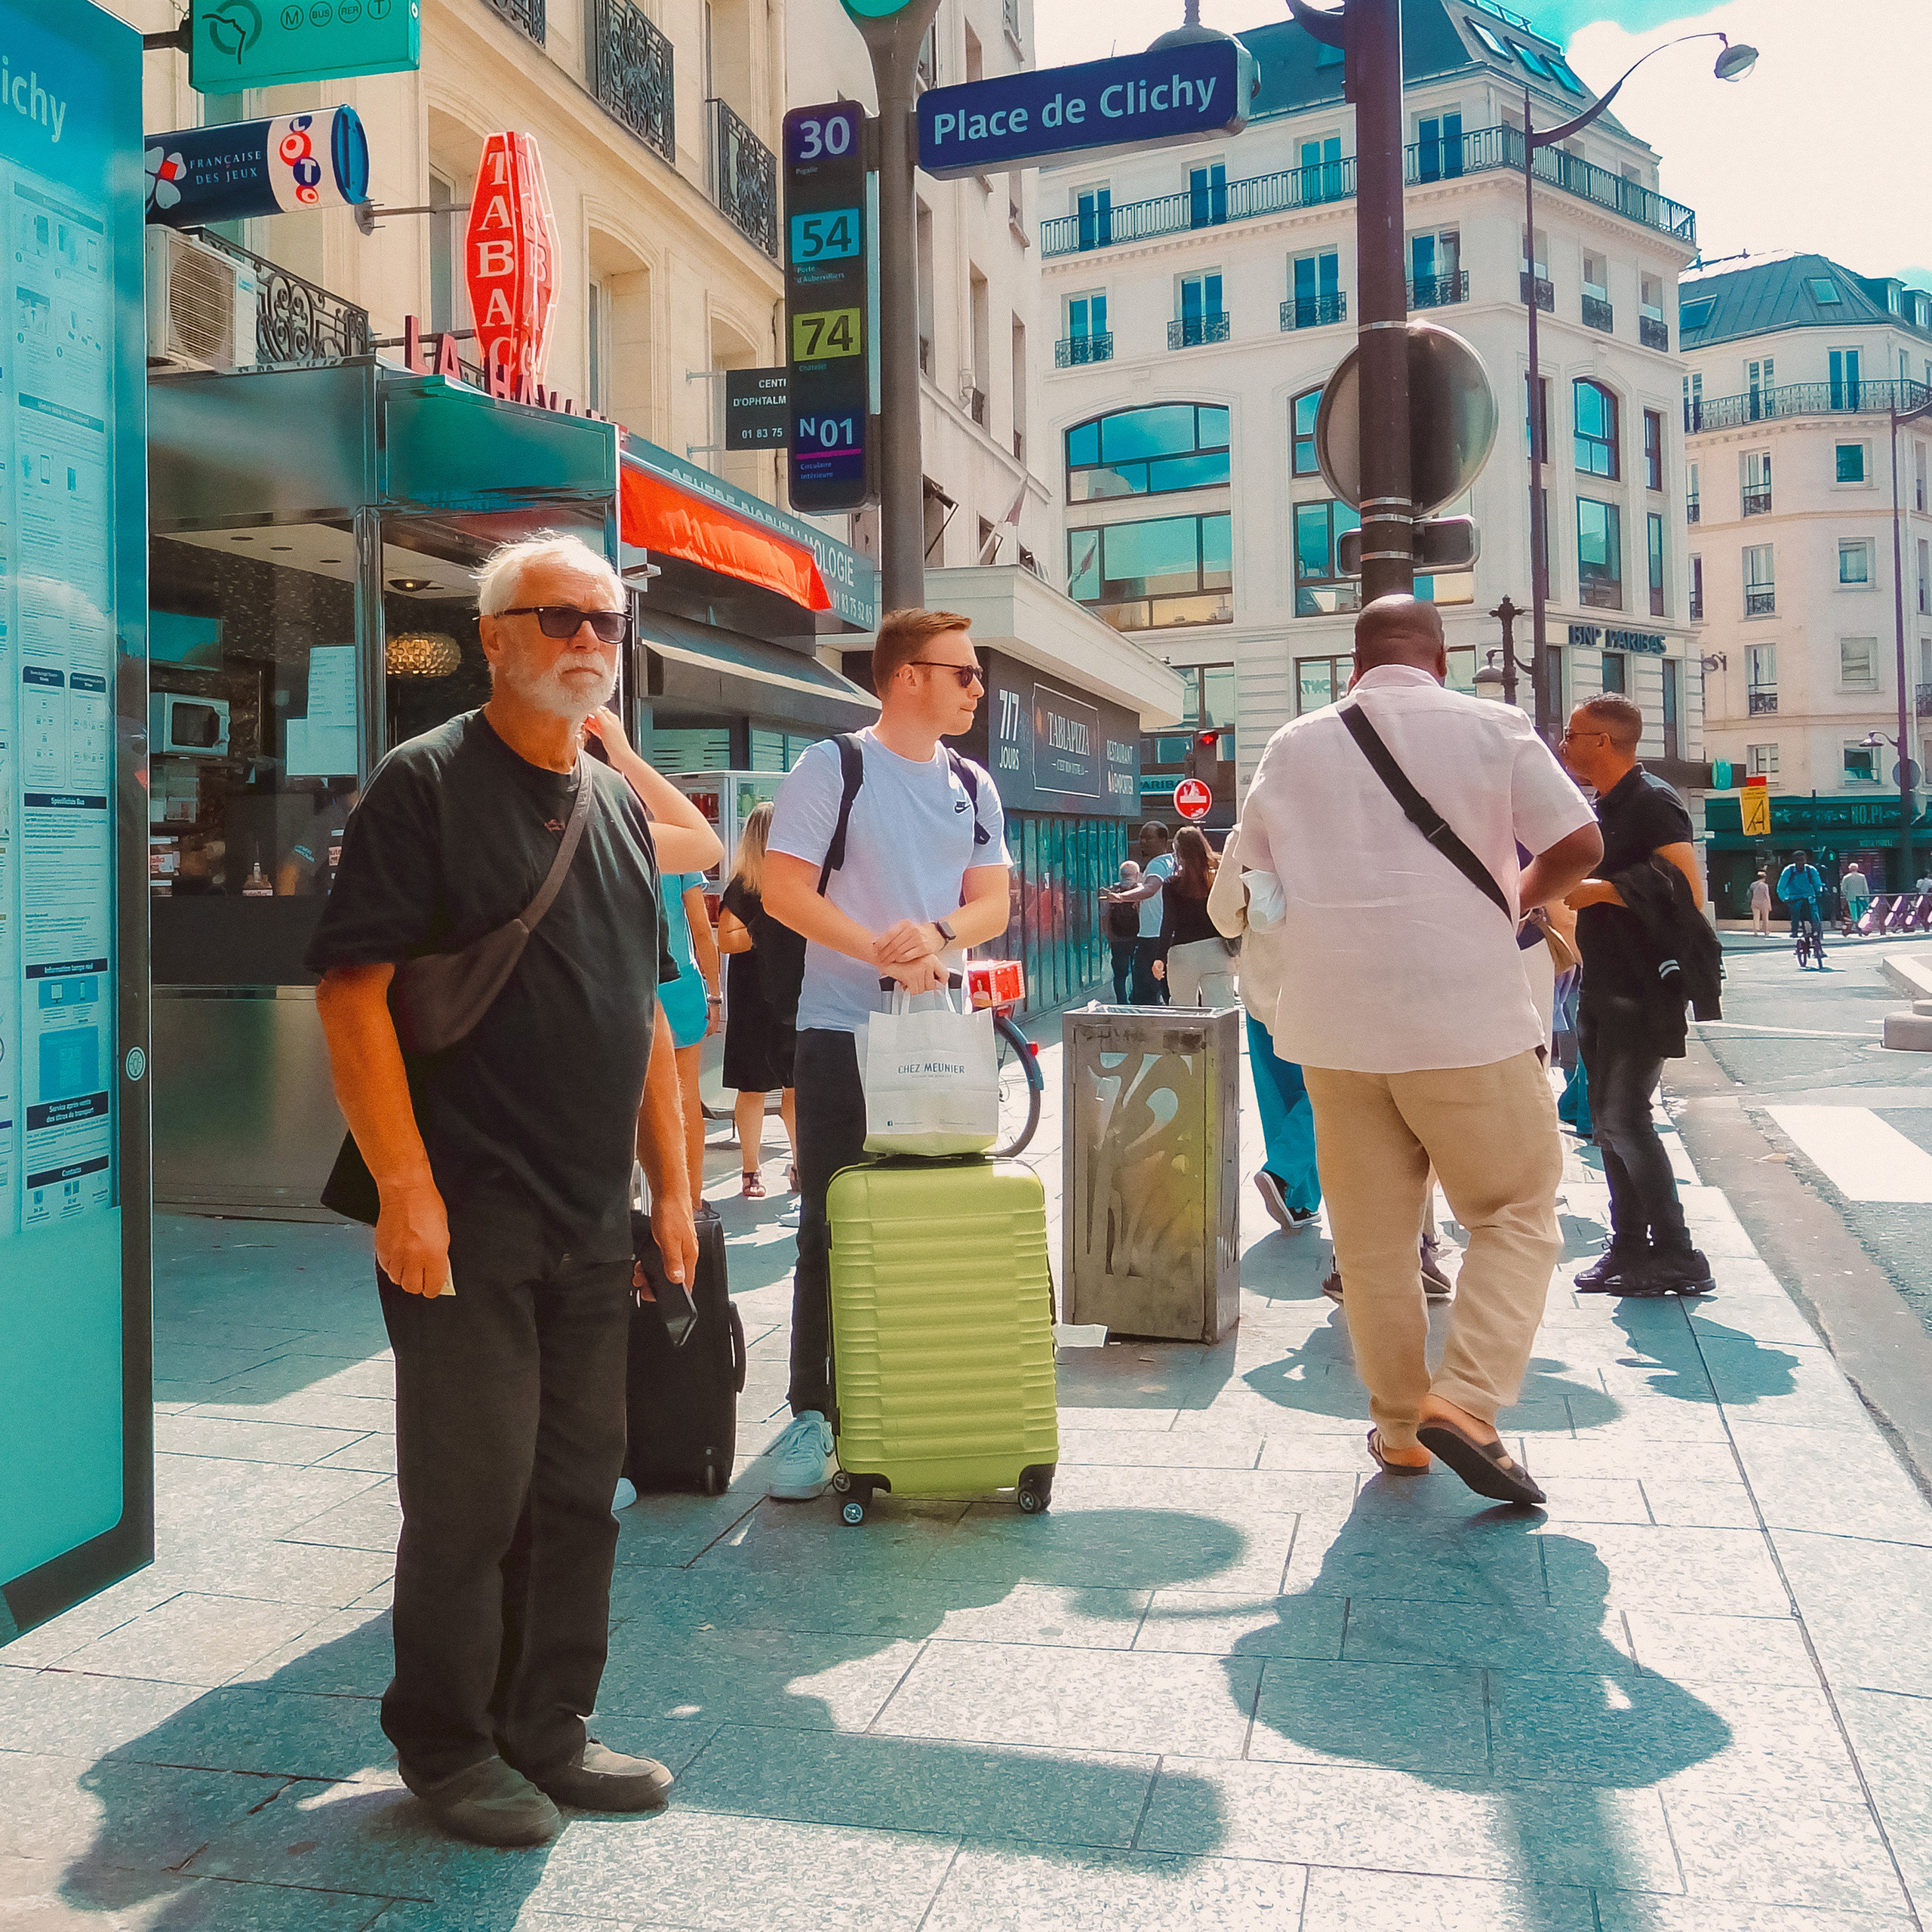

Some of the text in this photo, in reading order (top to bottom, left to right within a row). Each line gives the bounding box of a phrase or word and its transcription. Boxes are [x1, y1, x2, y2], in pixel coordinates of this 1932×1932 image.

[312, 9, 330, 19] BUS
[341, 6, 358, 15] RER
[934, 73, 1217, 145] Place de Clichy
[799, 115, 852, 160] 30
[189, 150, 262, 170] FRANÇAISE
[196, 167, 258, 186] DES JEUX
[279, 118, 319, 204] LOTO
[801, 215, 852, 258] 54
[475, 151, 518, 371] TABAC
[405, 315, 463, 381] LA
[801, 314, 854, 356] 74
[742, 427, 783, 439] 01 83 75
[1568, 625, 1667, 654] BNP PARIBAS
[998, 745, 1020, 771] JOURS
[898, 1062, 965, 1075] CHEZ MEUNIER
